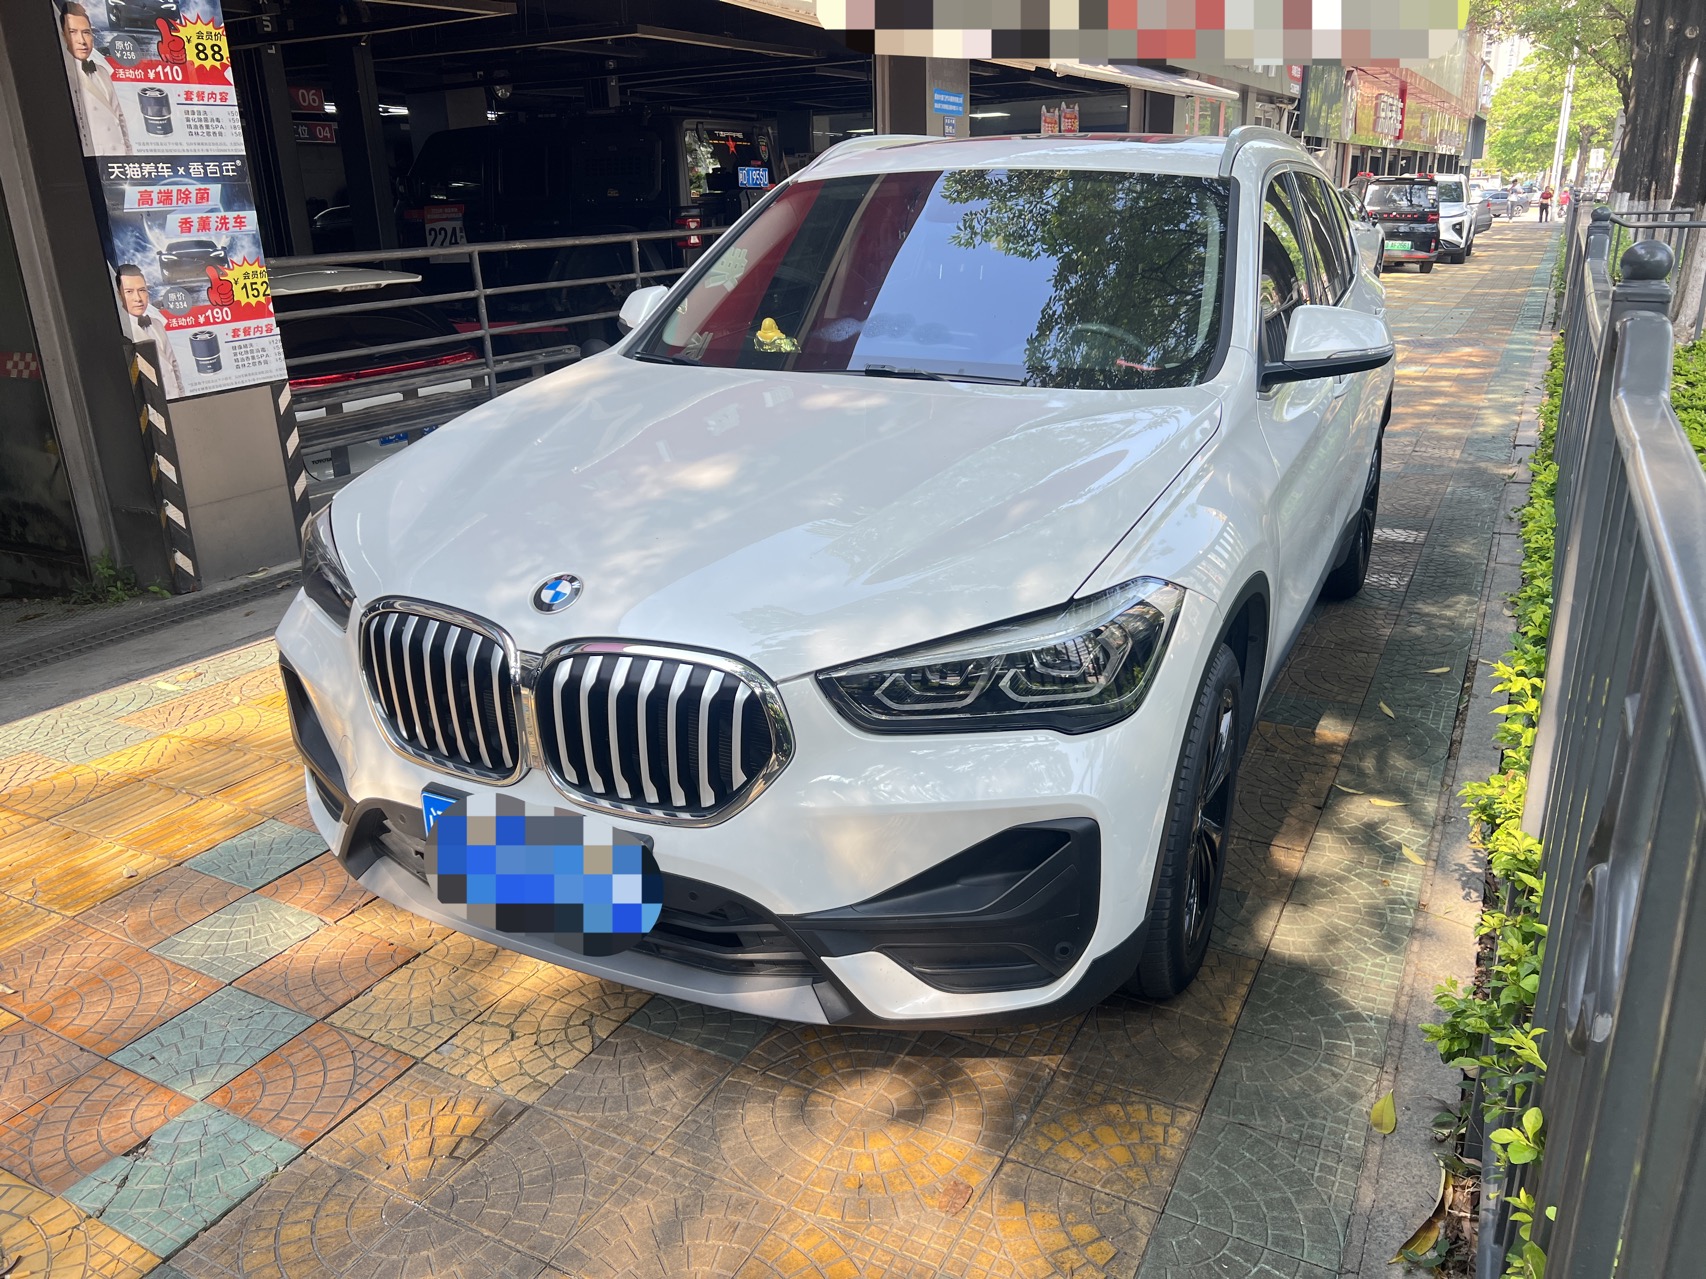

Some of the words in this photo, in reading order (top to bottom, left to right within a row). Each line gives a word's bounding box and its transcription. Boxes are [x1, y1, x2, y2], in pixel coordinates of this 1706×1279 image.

[195, 31, 222, 42] 会员价
[115, 41, 133, 50] 原价
[194, 43, 224, 61] 88
[115, 69, 144, 79] 活动价
[147, 65, 182, 81] ¥110
[298, 89, 319, 106] 06
[316, 126, 331, 139] 04
[107, 162, 173, 179] 天猫养车
[137, 187, 211, 207] 高端除菌
[178, 214, 247, 234] 香薰洗车
[428, 226, 459, 247] 224
[242, 269, 268, 280] 会员价
[168, 292, 185, 302] 原价
[241, 280, 271, 299] 152
[168, 316, 195, 328] 活动价
[197, 306, 232, 324] ¥190
[311, 457, 332, 465] TOYOTA
